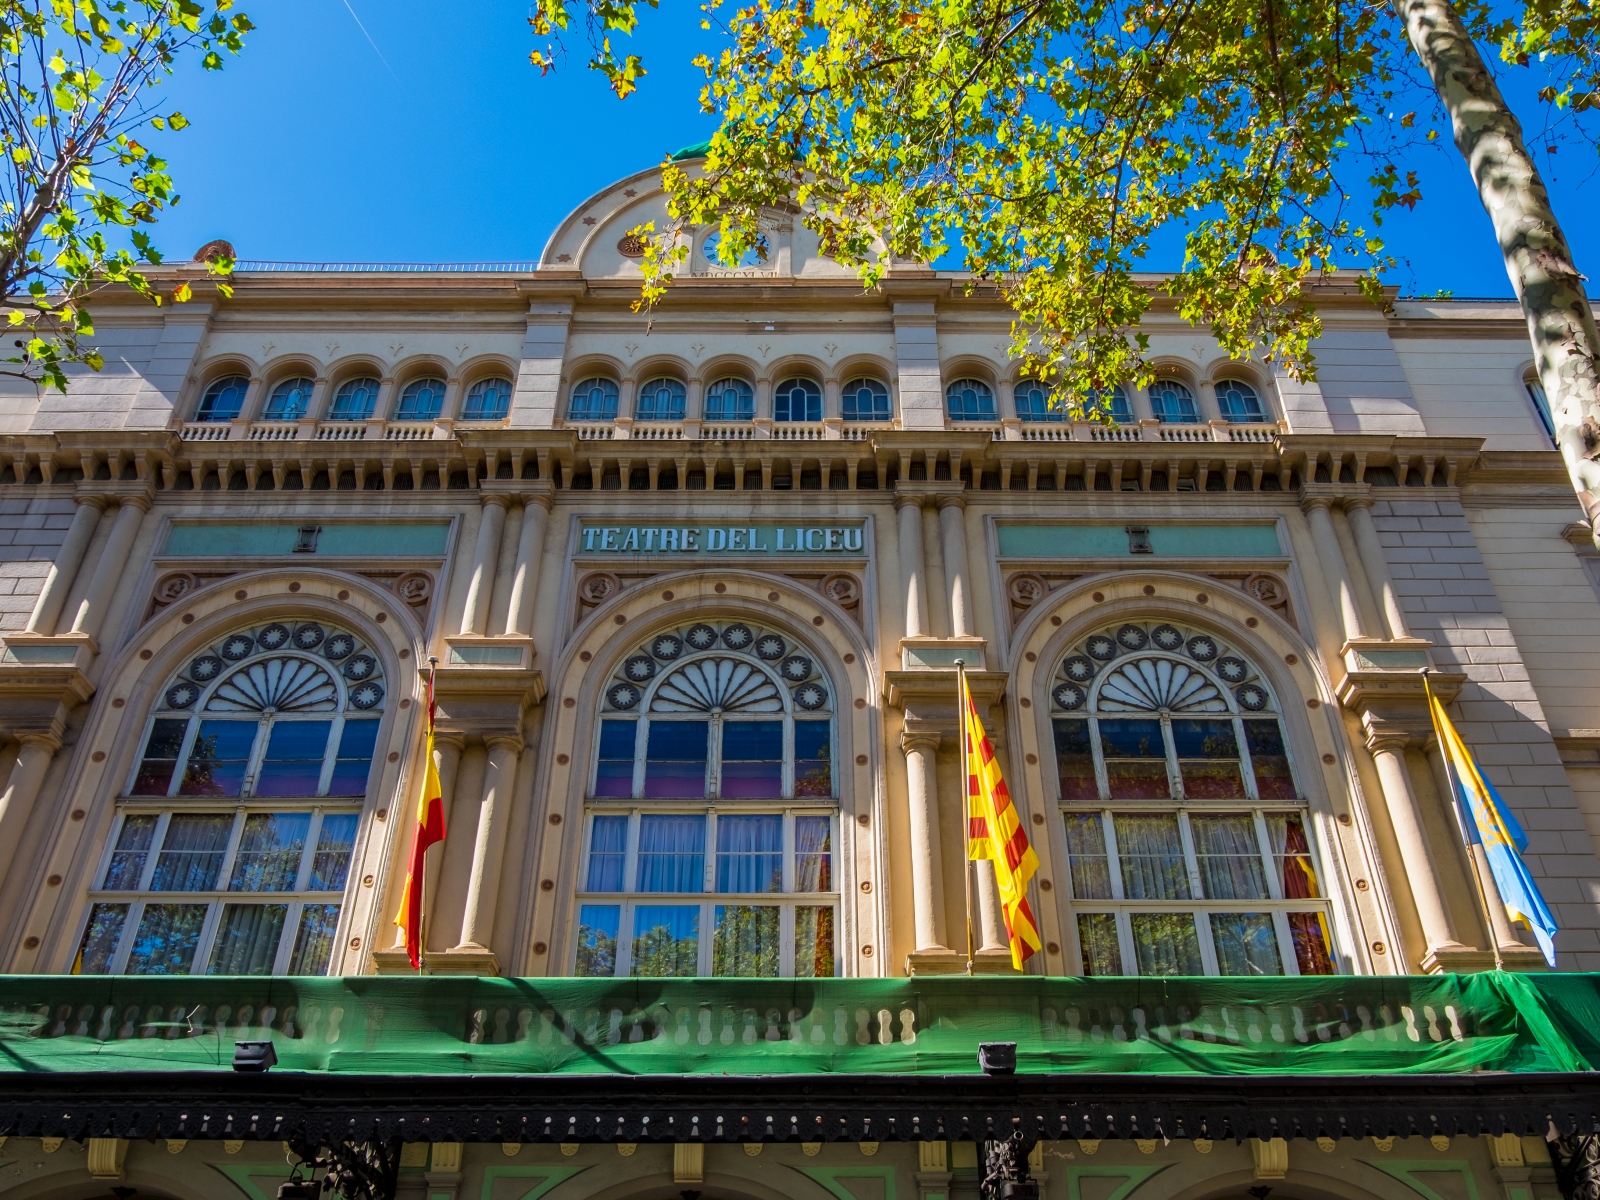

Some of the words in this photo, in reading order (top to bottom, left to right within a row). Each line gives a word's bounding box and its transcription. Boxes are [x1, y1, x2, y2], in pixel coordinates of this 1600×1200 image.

[582, 528, 701, 551] TEATRE
[706, 528, 767, 551] DEL
[775, 528, 863, 551] LICEU
